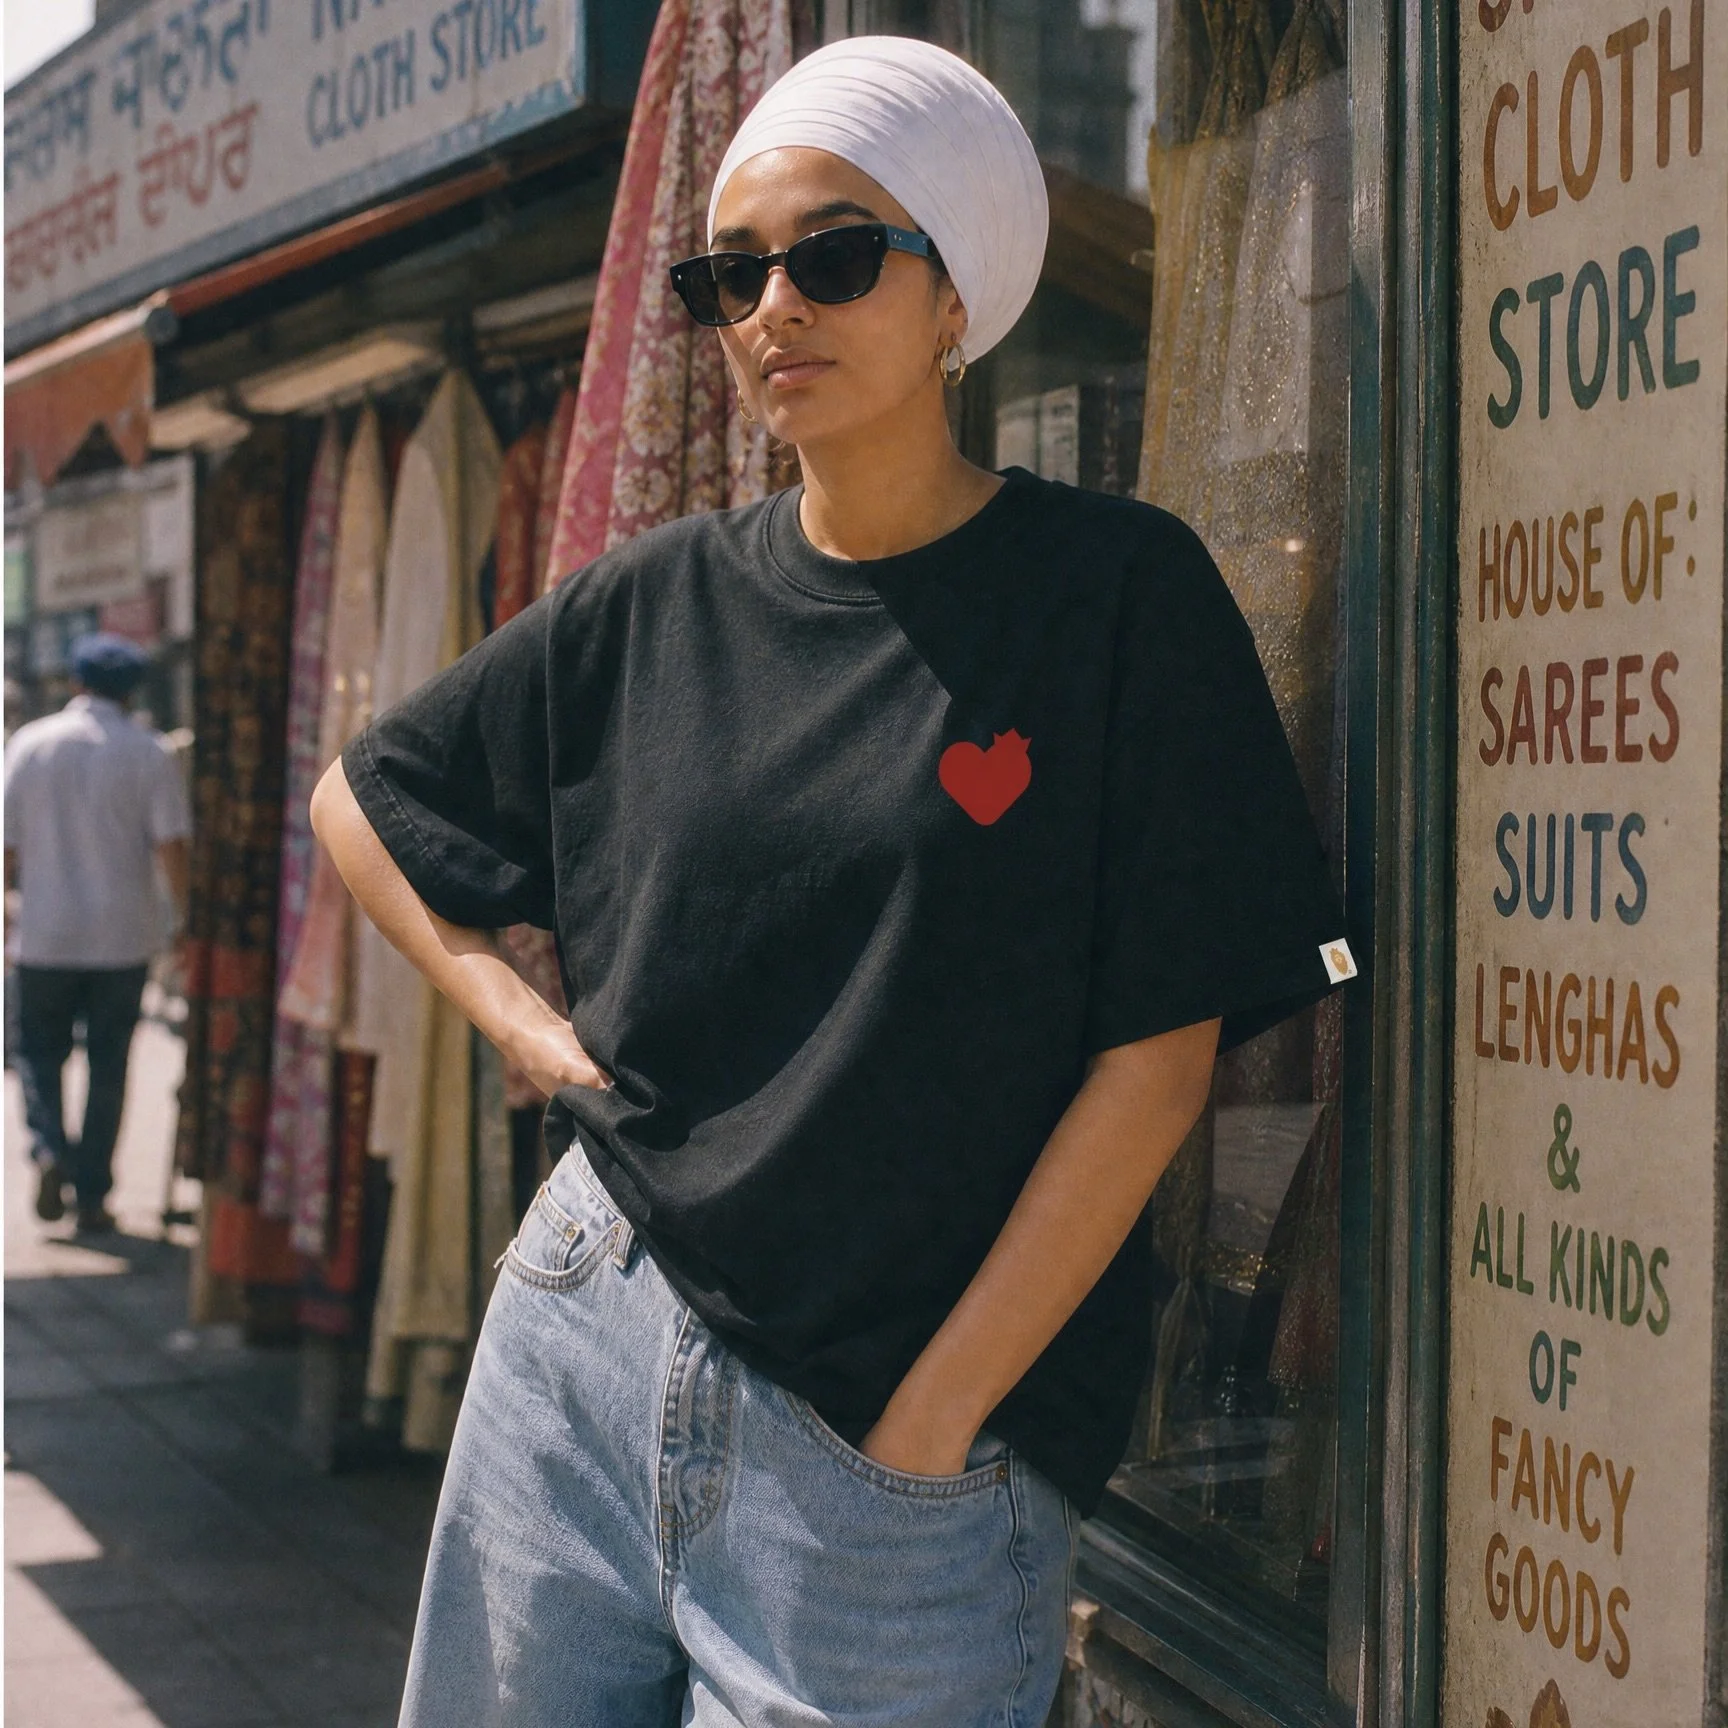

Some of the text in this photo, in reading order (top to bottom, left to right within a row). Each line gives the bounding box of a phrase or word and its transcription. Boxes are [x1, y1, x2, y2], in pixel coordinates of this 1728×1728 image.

[305, 29, 417, 149] CLOTH
[1483, 0, 1704, 231] CLOTH
[1487, 224, 1700, 429] STORE
[1478, 506, 1604, 623] HOUSE
[1478, 651, 1680, 767] SAREES
[1493, 811, 1647, 925] SUITS
[1475, 963, 1681, 1089] LENGHAS
[1547, 1103, 1581, 1193] &
[1470, 1201, 1670, 1336] ALL KINDS
[1529, 1330, 1582, 1411] OF
[1490, 1416, 1634, 1555] FANCY
[1485, 1532, 1631, 1679] GOODS
